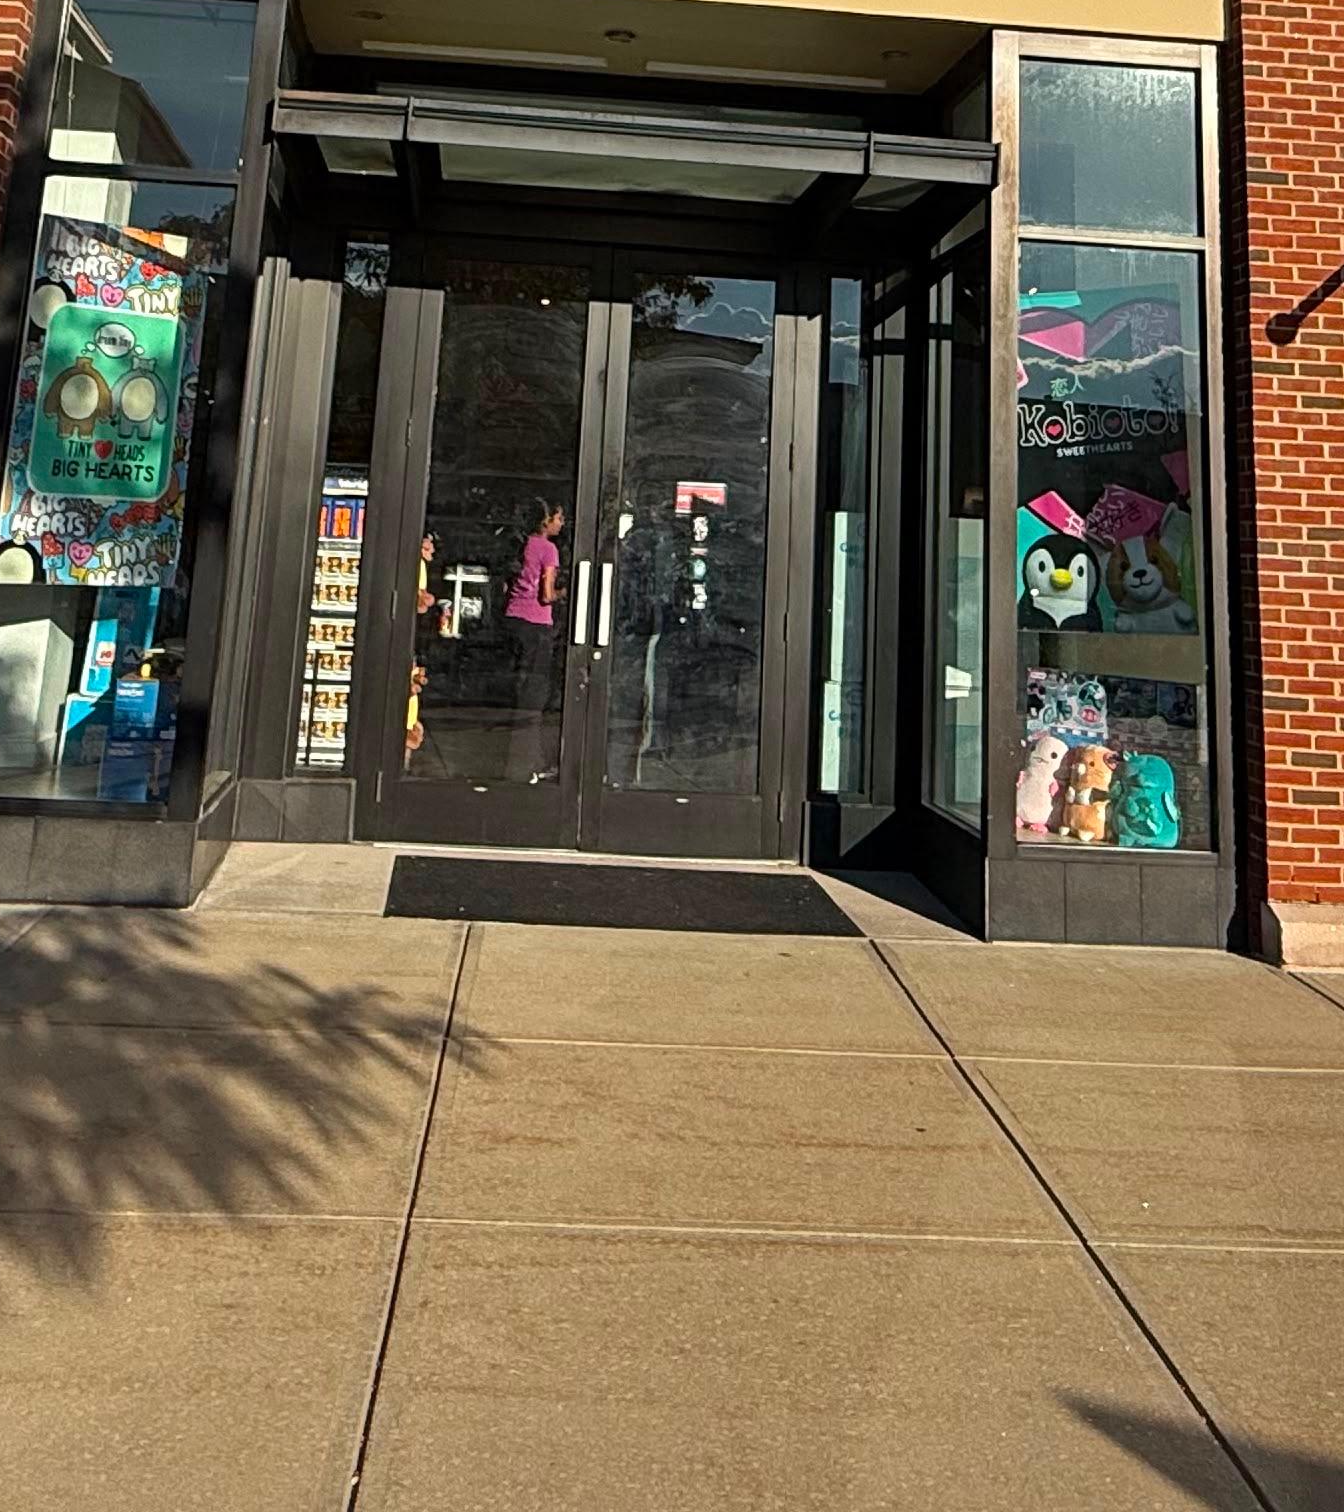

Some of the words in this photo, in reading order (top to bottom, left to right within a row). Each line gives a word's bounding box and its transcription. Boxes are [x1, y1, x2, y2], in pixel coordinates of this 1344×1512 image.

[47, 254, 121, 282] HEARTS
[126, 286, 180, 315] TINY
[68, 439, 92, 459] TINY
[113, 444, 146, 462] HEADS
[1056, 441, 1134, 458] SWEETHEARTS
[51, 458, 80, 478] BIG
[84, 462, 156, 483] HEARTS
[29, 492, 66, 517] BIG
[10, 511, 87, 538] HEARTS
[95, 536, 151, 569] TINY
[86, 560, 161, 587] HEADS
